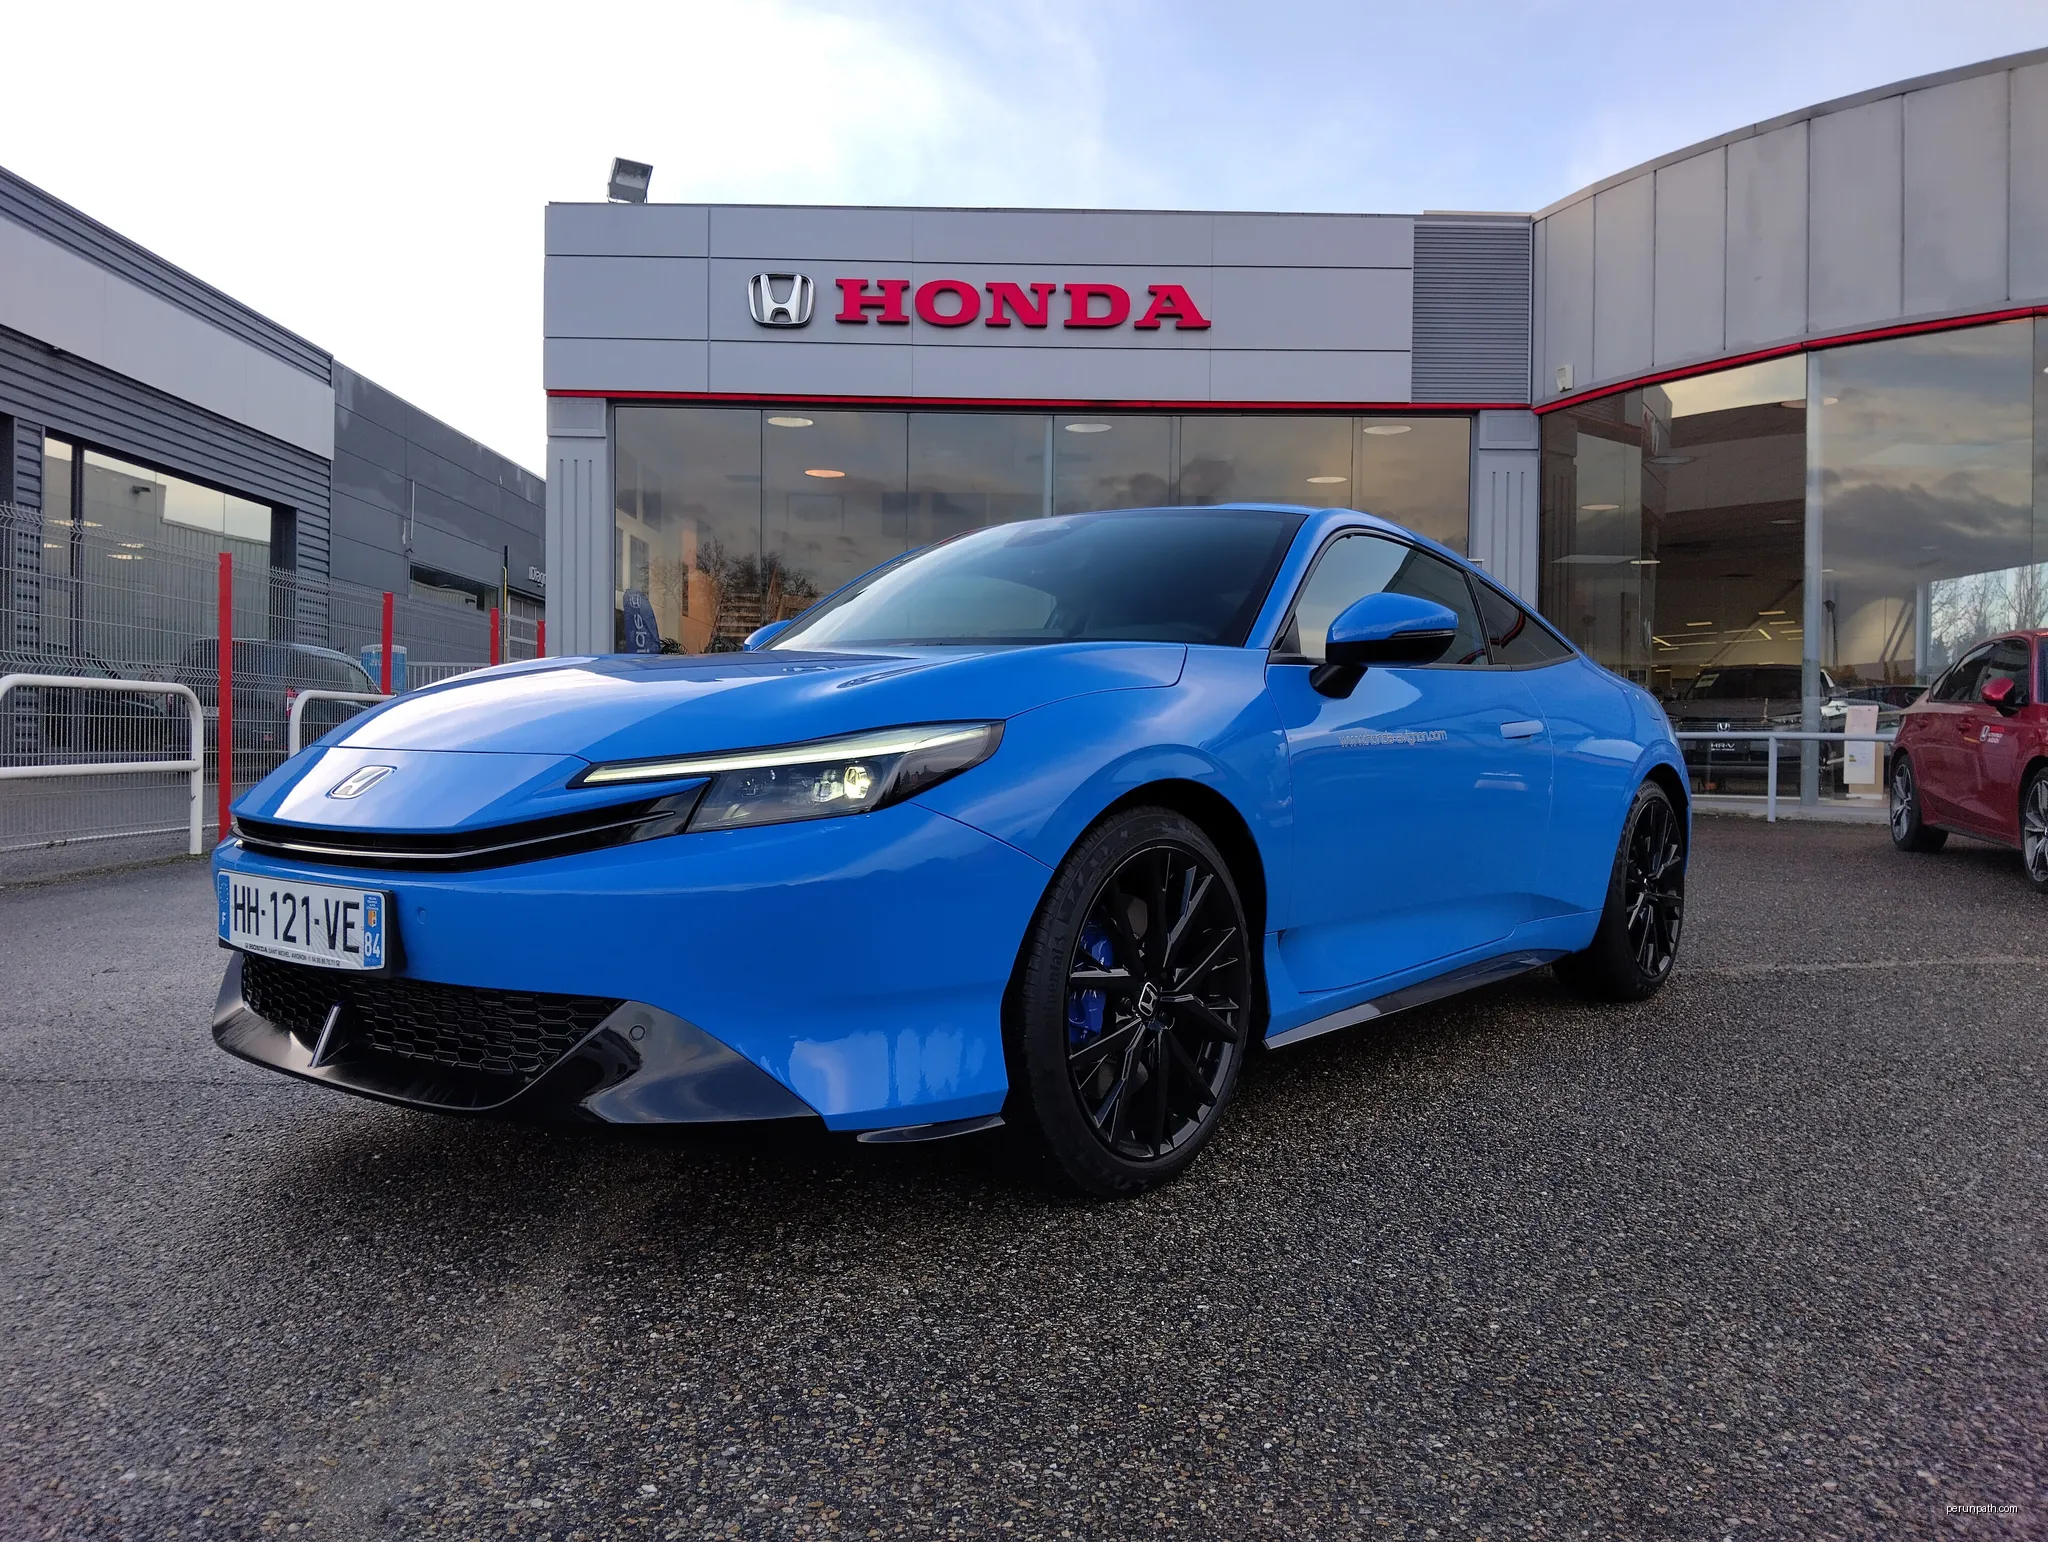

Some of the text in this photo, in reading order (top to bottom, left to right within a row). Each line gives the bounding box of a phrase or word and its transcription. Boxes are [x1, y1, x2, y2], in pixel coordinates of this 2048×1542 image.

[835, 277, 1212, 330] HONDA
[233, 883, 360, 954] HH-121-VE
[364, 931, 381, 958] 84
